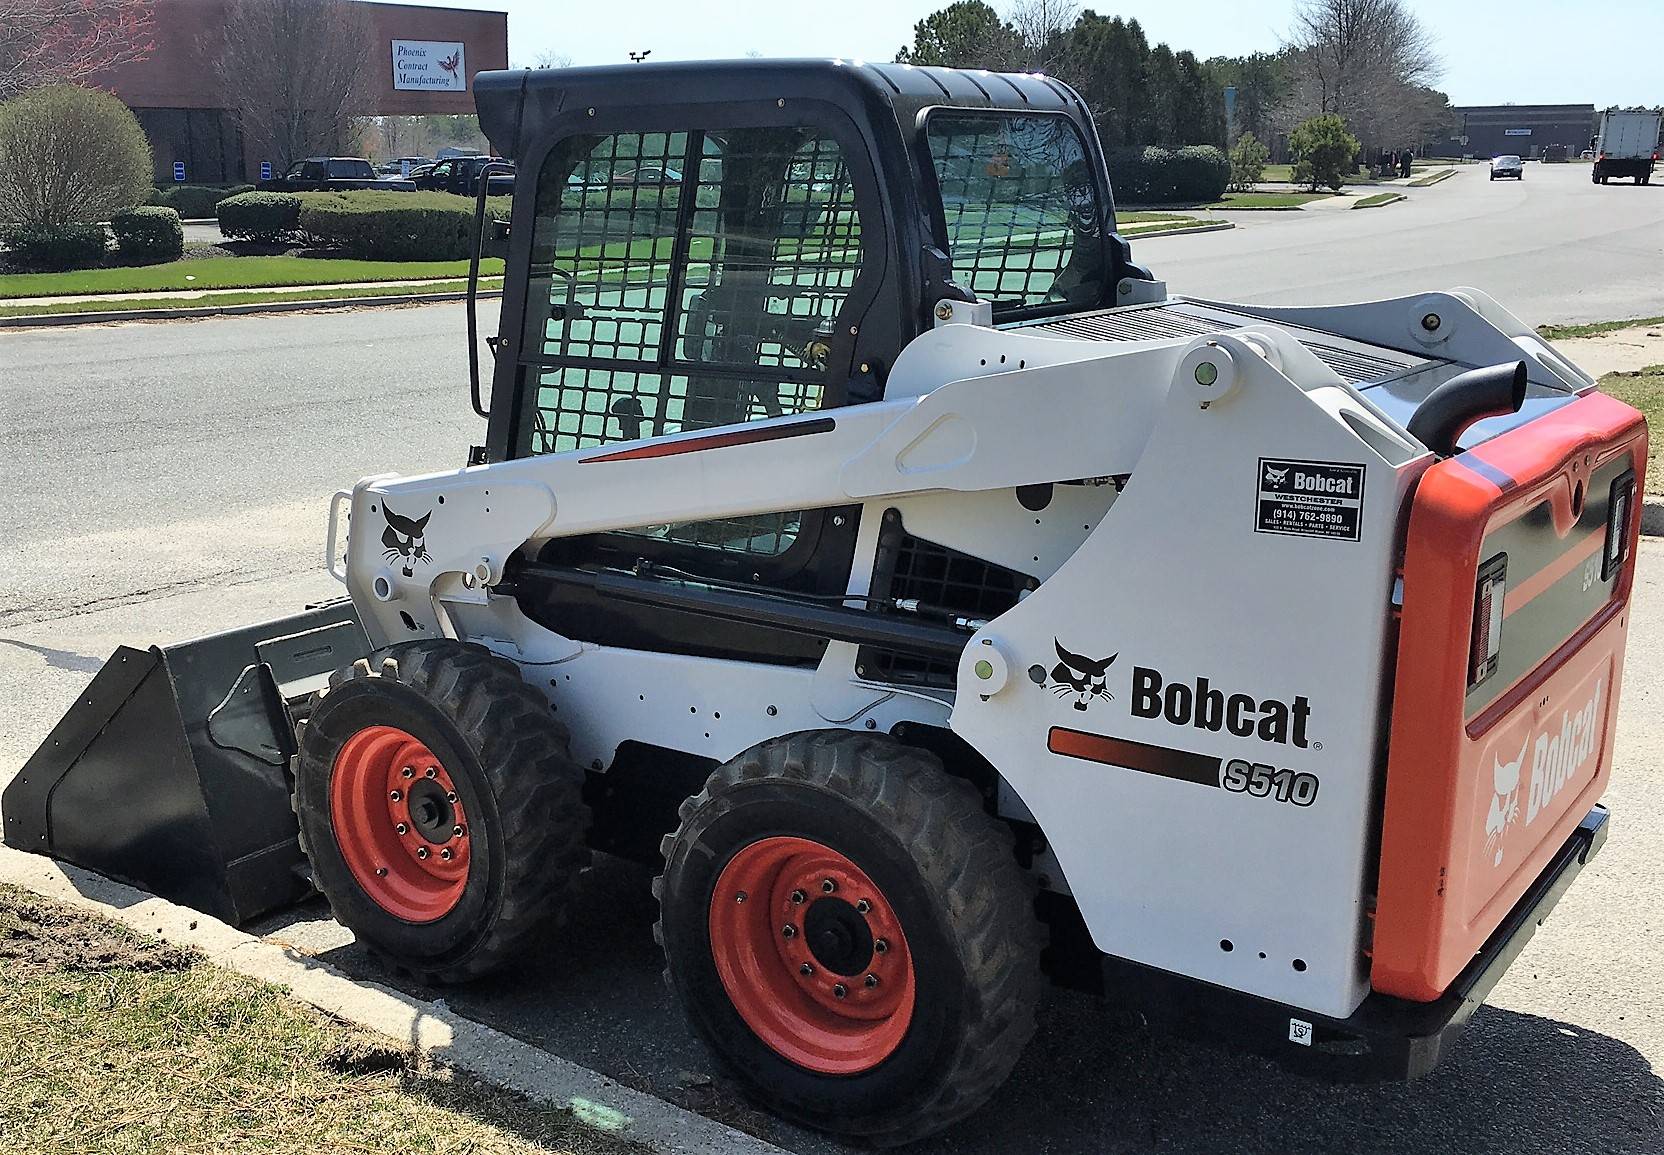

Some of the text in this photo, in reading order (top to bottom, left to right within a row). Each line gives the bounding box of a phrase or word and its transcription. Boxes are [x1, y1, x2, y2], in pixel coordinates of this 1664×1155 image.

[397, 45, 427, 57] Phoenix
[397, 59, 428, 71] Contract
[397, 73, 450, 87] Manufacturing
[1294, 471, 1353, 494] Bobcat
[1274, 493, 1343, 505] WESTCHESTER
[1273, 509, 1343, 524] (914) 762-9890
[1131, 666, 1311, 749] Bobcat
[1525, 678, 1601, 828] Bobcat
[1223, 759, 1320, 808] S510
